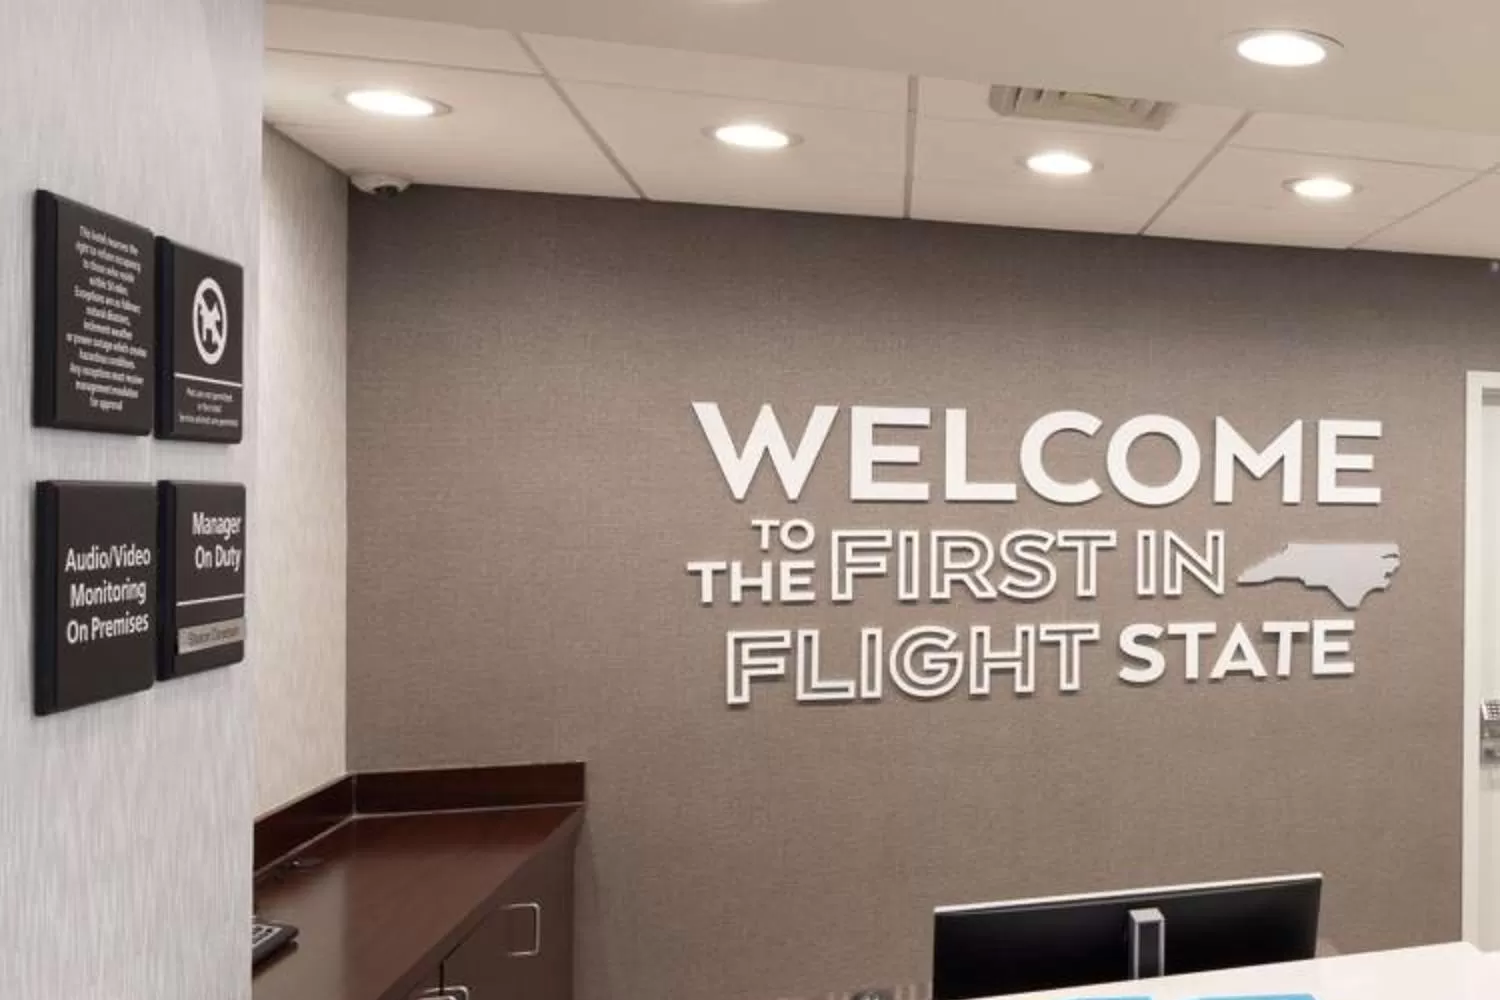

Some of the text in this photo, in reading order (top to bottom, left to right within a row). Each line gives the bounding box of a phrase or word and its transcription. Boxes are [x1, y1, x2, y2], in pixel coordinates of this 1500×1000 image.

[691, 401, 1383, 505] WELCOME
[192, 511, 243, 541] Manager
[751, 518, 815, 552] TO
[64, 543, 151, 572] Audio/Video
[195, 543, 243, 573] On Duty
[831, 529, 1225, 602] FIRST IN
[70, 577, 147, 608] Monitoring
[687, 560, 816, 604] THE
[67, 611, 149, 645] On Premises
[725, 619, 1355, 704] FLIGHT STATE
